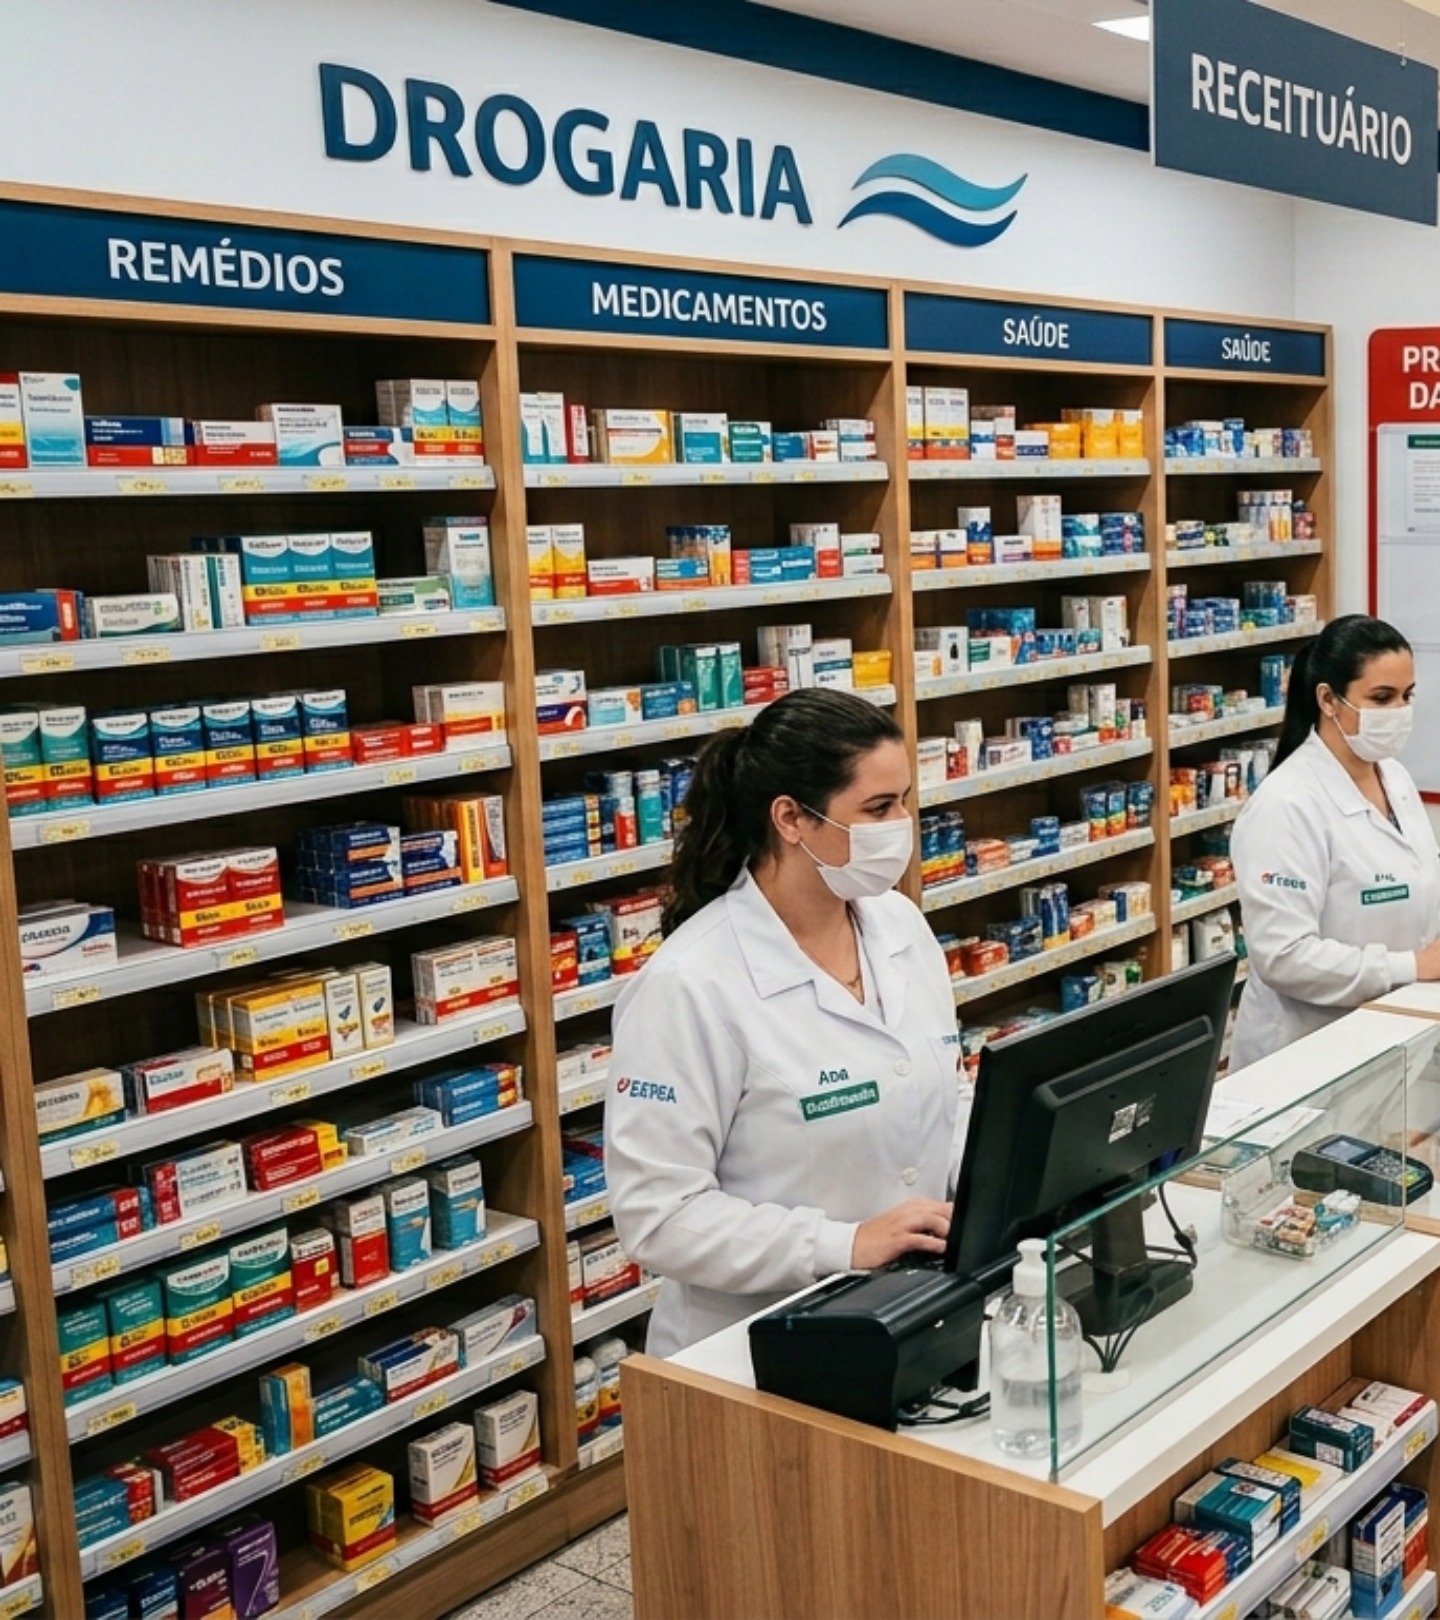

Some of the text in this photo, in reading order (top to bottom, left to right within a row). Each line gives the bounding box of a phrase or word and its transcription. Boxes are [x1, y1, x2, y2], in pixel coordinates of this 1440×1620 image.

[1191, 53, 1413, 165] RECEITUÁRIO
[319, 62, 813, 226] DROGARIA
[107, 237, 345, 298] REMÉDIOS
[591, 281, 828, 332] MEDICAMENTOS
[1002, 315, 1070, 350] SAÚDE
[1221, 332, 1272, 363] SAÚDE
